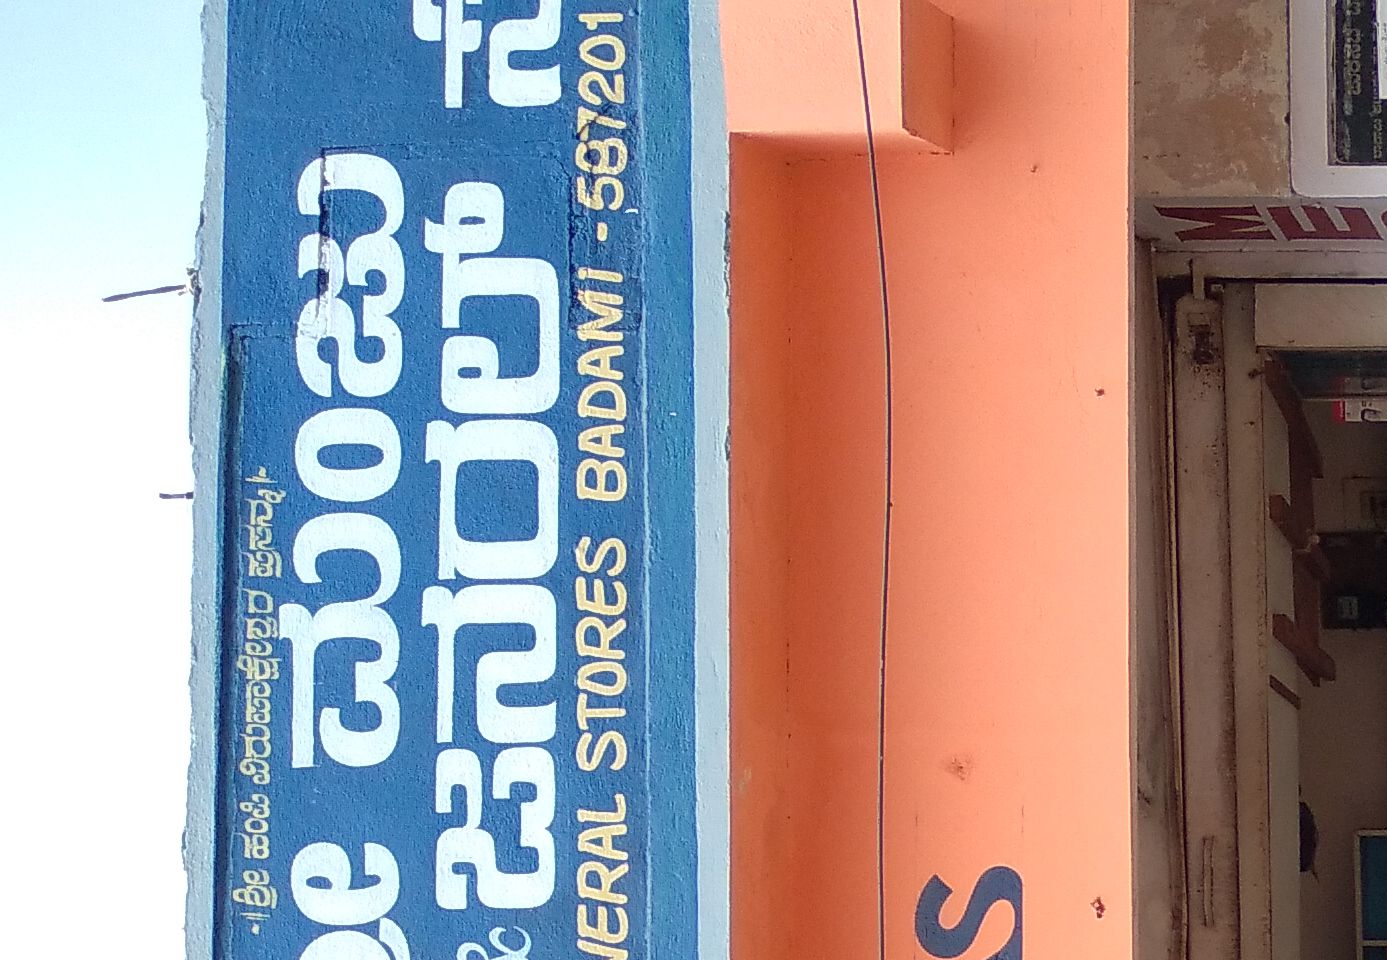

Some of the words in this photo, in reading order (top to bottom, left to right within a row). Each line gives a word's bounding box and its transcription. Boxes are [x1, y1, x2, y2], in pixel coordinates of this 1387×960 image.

[278, 152, 405, 769] ಮಂಜು
[420, 181, 561, 910] ಜನರಲ್
[576, 268, 628, 501] BADAMI
[575, 537, 628, 771] STORES
